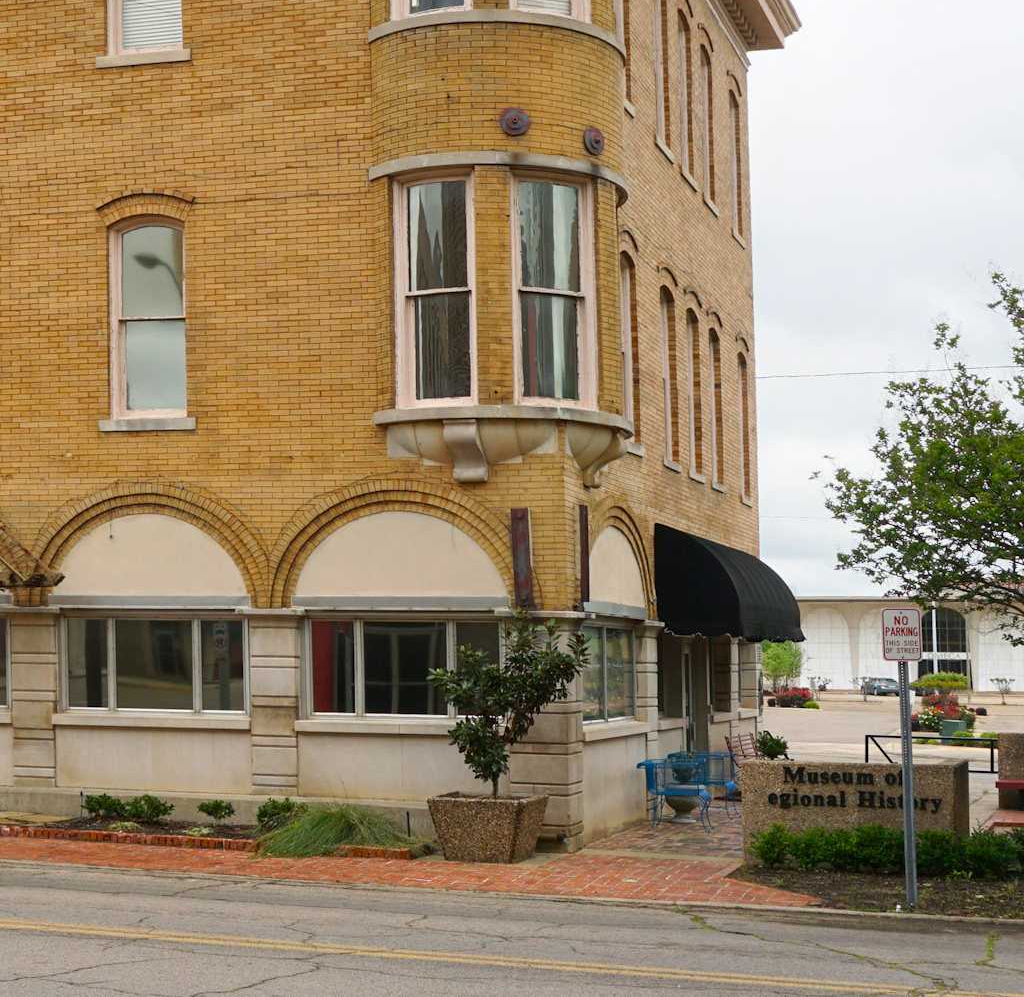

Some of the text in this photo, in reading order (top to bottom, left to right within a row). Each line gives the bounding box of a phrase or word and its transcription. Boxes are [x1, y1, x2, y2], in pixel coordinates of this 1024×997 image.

[894, 616, 909, 625] NO
[885, 627, 918, 636] PARKING
[783, 766, 874, 785] Museum
[768, 789, 846, 809] egional
